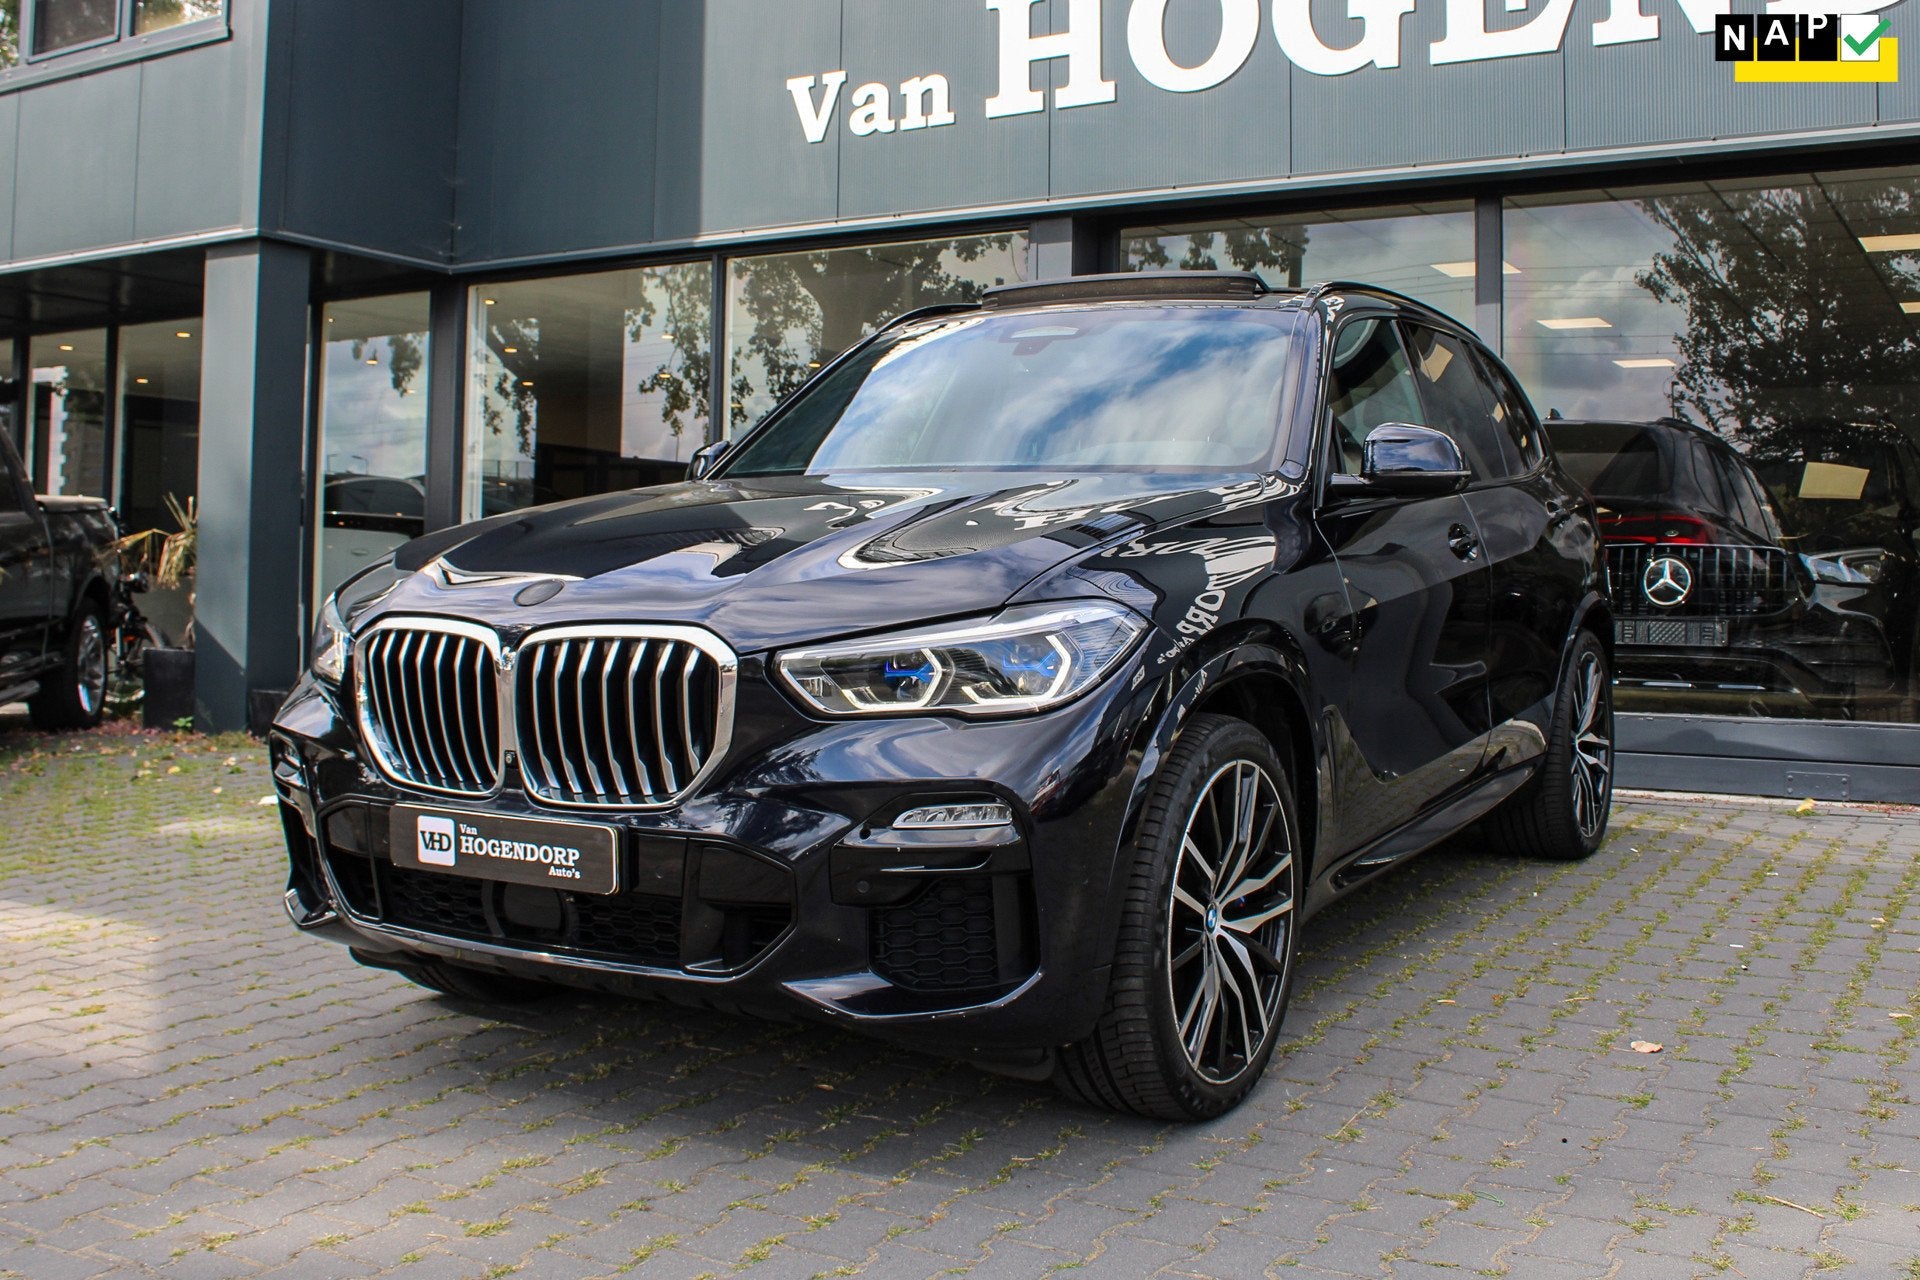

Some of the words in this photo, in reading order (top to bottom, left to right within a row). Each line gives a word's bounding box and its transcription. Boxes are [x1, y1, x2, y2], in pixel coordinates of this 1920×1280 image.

[786, 70, 955, 143] Van
[459, 824, 477, 835] Van
[460, 836, 580, 867] HOGENDORP
[548, 866, 581, 879] Auto's
